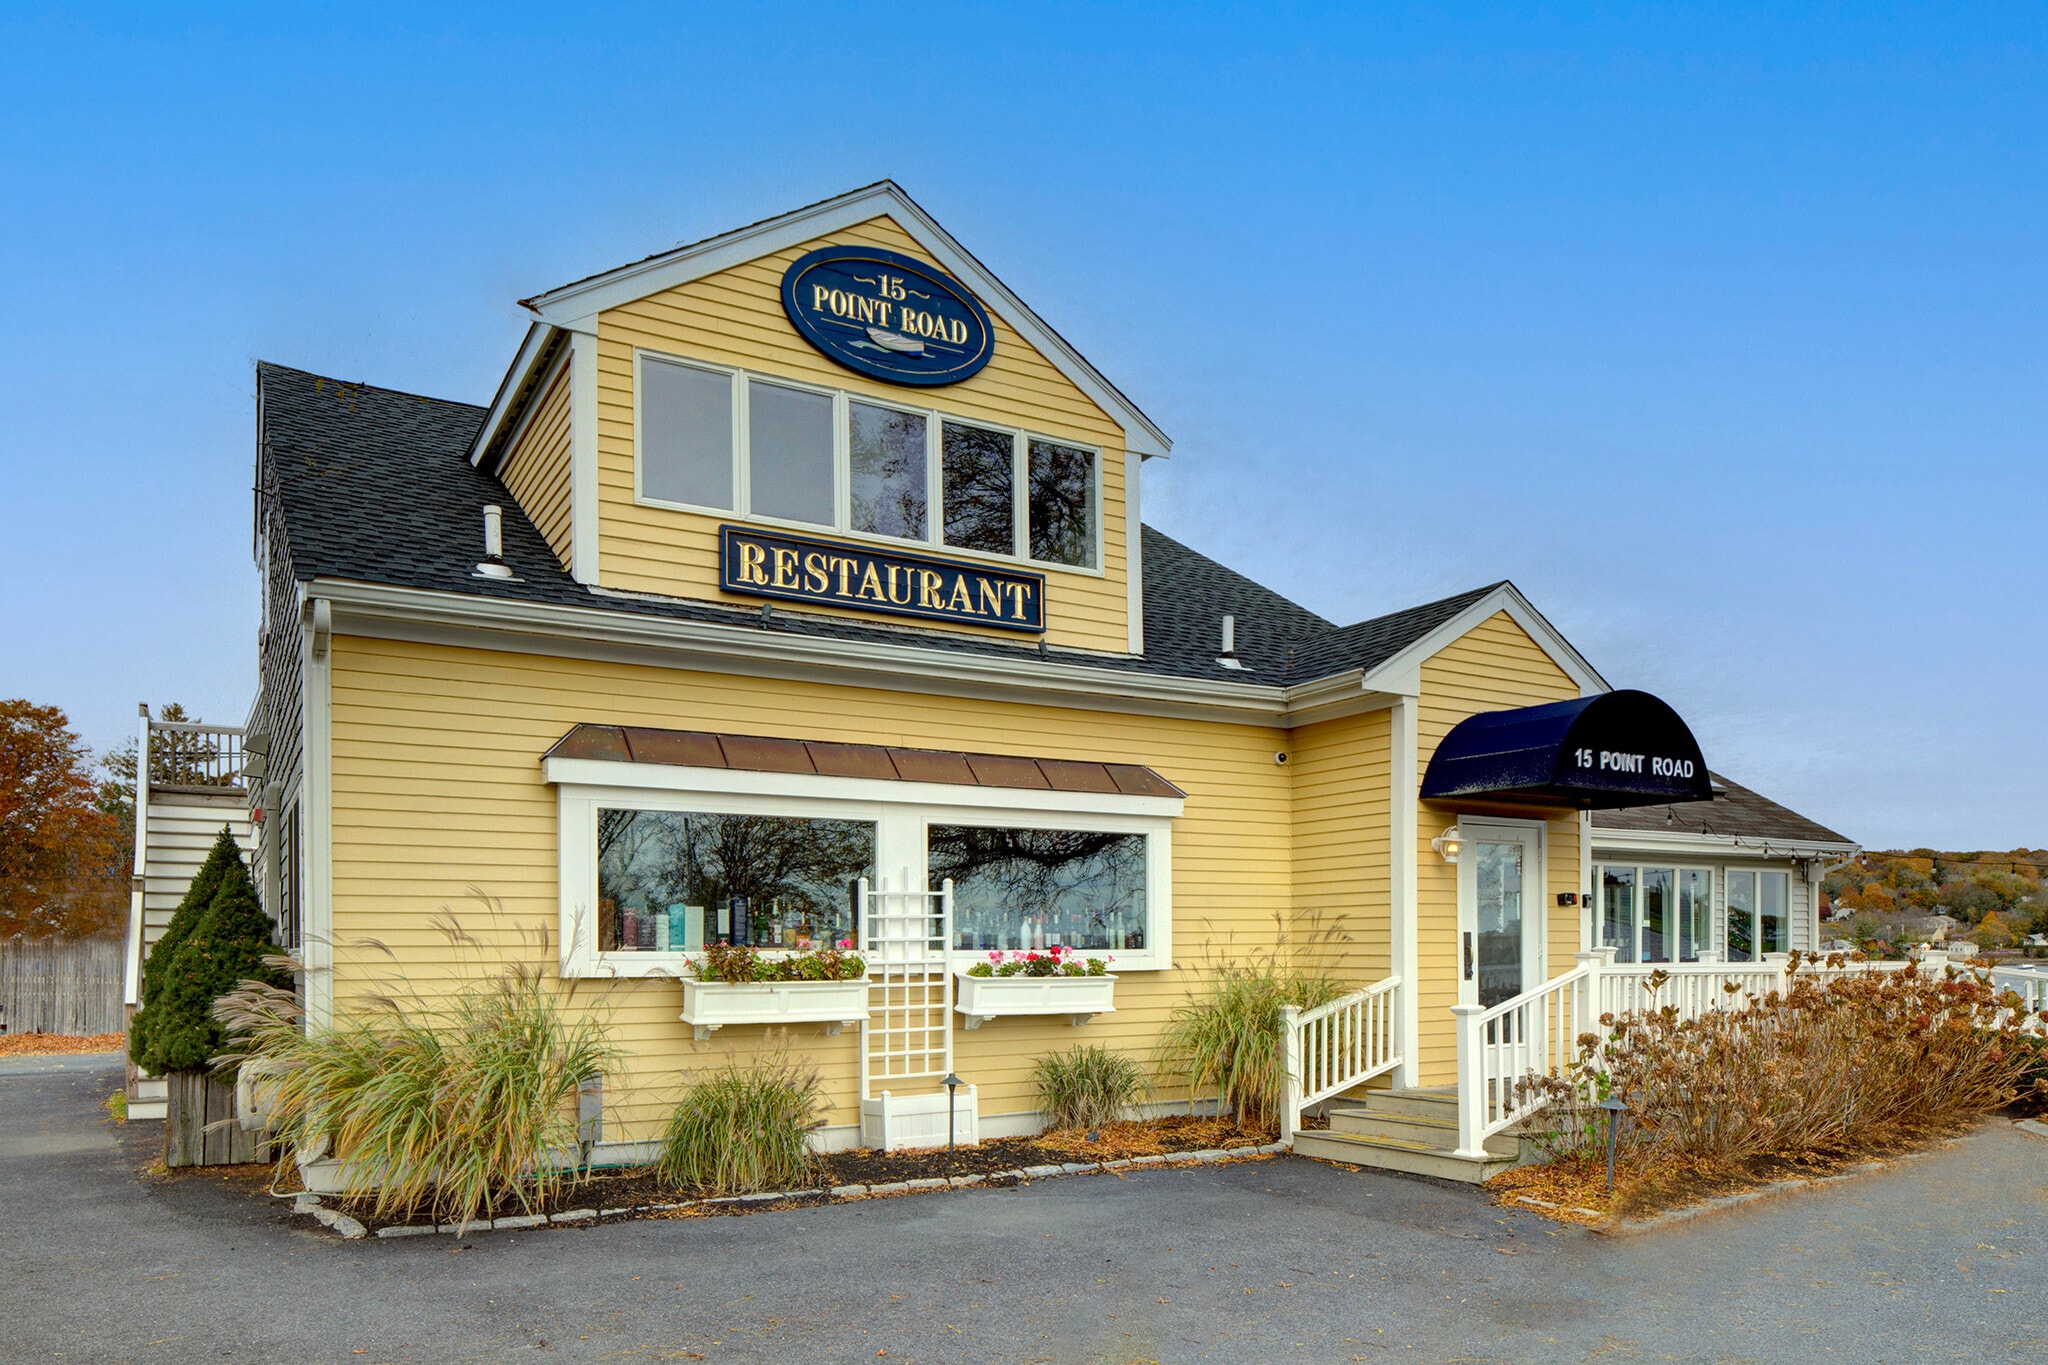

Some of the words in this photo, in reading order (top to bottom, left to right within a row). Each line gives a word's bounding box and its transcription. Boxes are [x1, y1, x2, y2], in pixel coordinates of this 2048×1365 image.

[878, 274, 906, 300] 15
[812, 284, 892, 327] POINT
[899, 306, 968, 345] ROAD
[736, 540, 1031, 620] RESTAURANT
[1575, 748, 1593, 768] 15
[1600, 751, 1645, 773] POINT
[1652, 757, 1694, 778] ROAD
